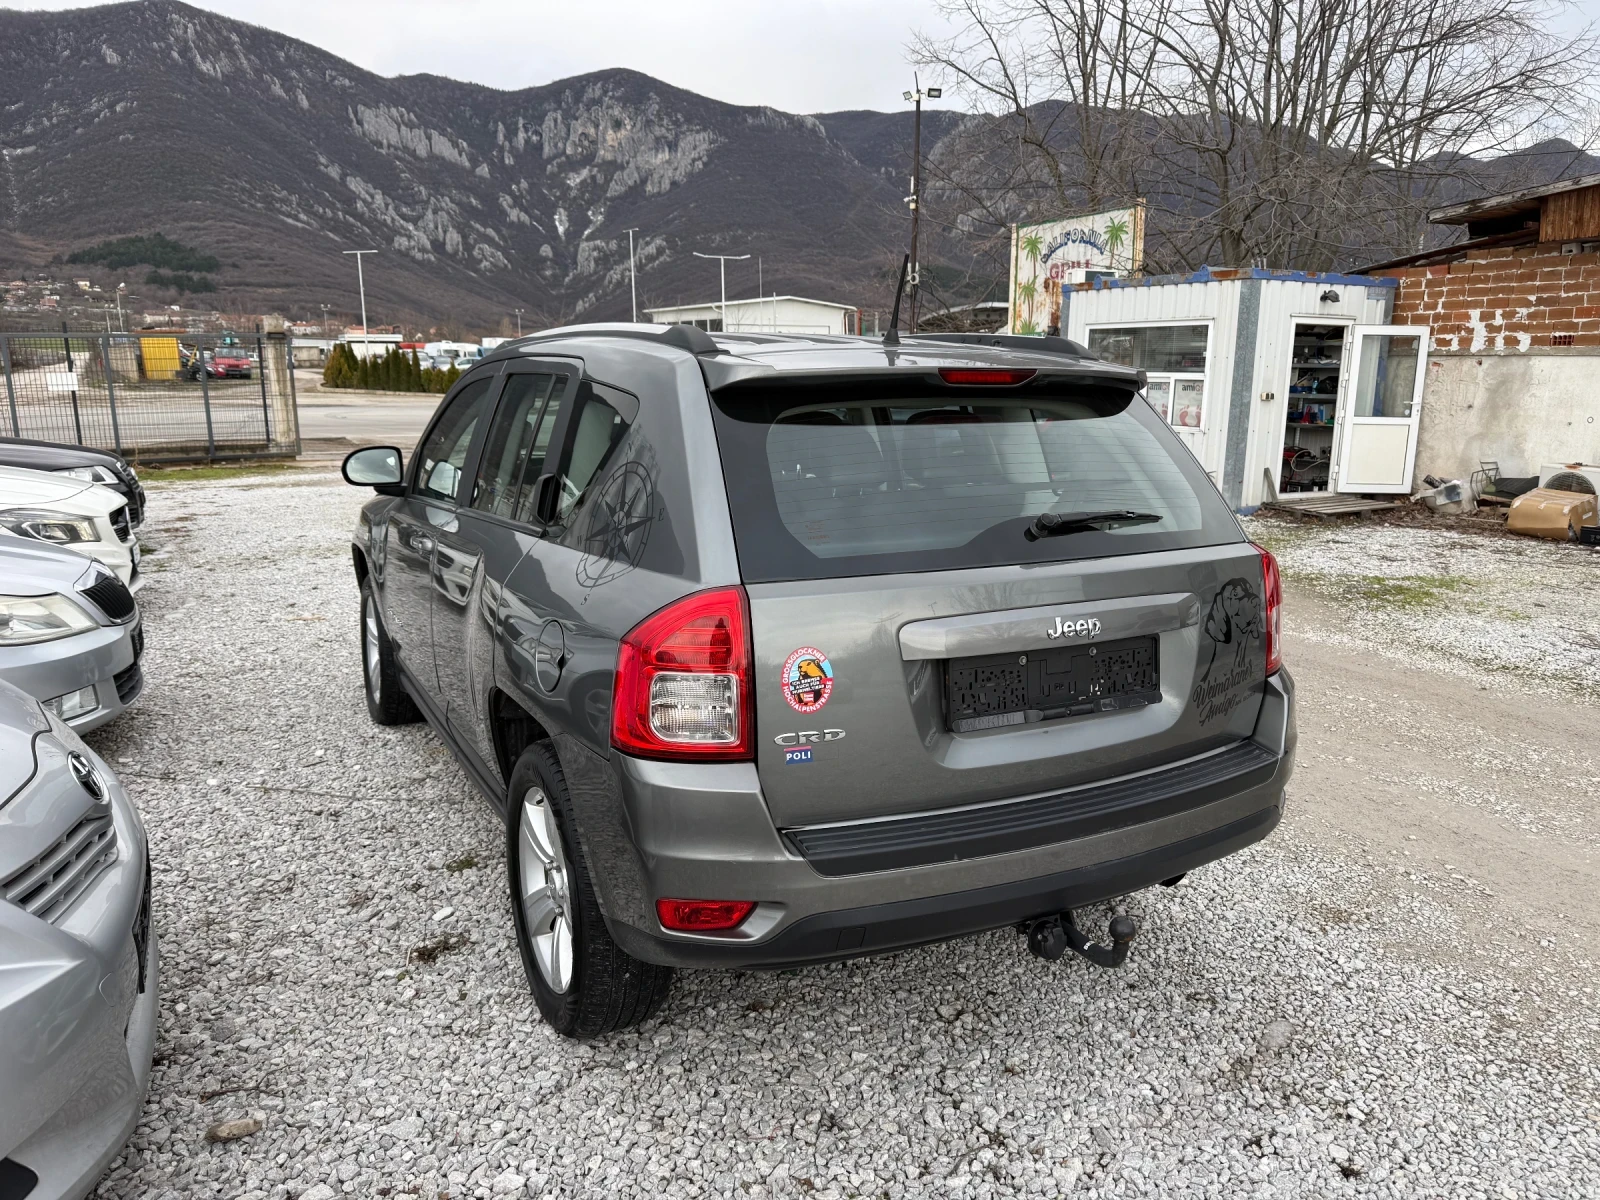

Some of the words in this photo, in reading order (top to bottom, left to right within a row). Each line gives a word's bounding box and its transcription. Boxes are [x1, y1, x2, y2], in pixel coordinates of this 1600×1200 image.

[1040, 228, 1108, 264] CALIFORNIA
[1047, 616, 1102, 640] Jeep
[783, 648, 825, 683] GROSSGLOCKNER
[783, 681, 832, 712] HOCHALPENSTRASSE
[774, 728, 846, 745] CRD
[786, 751, 811, 760] POLI
